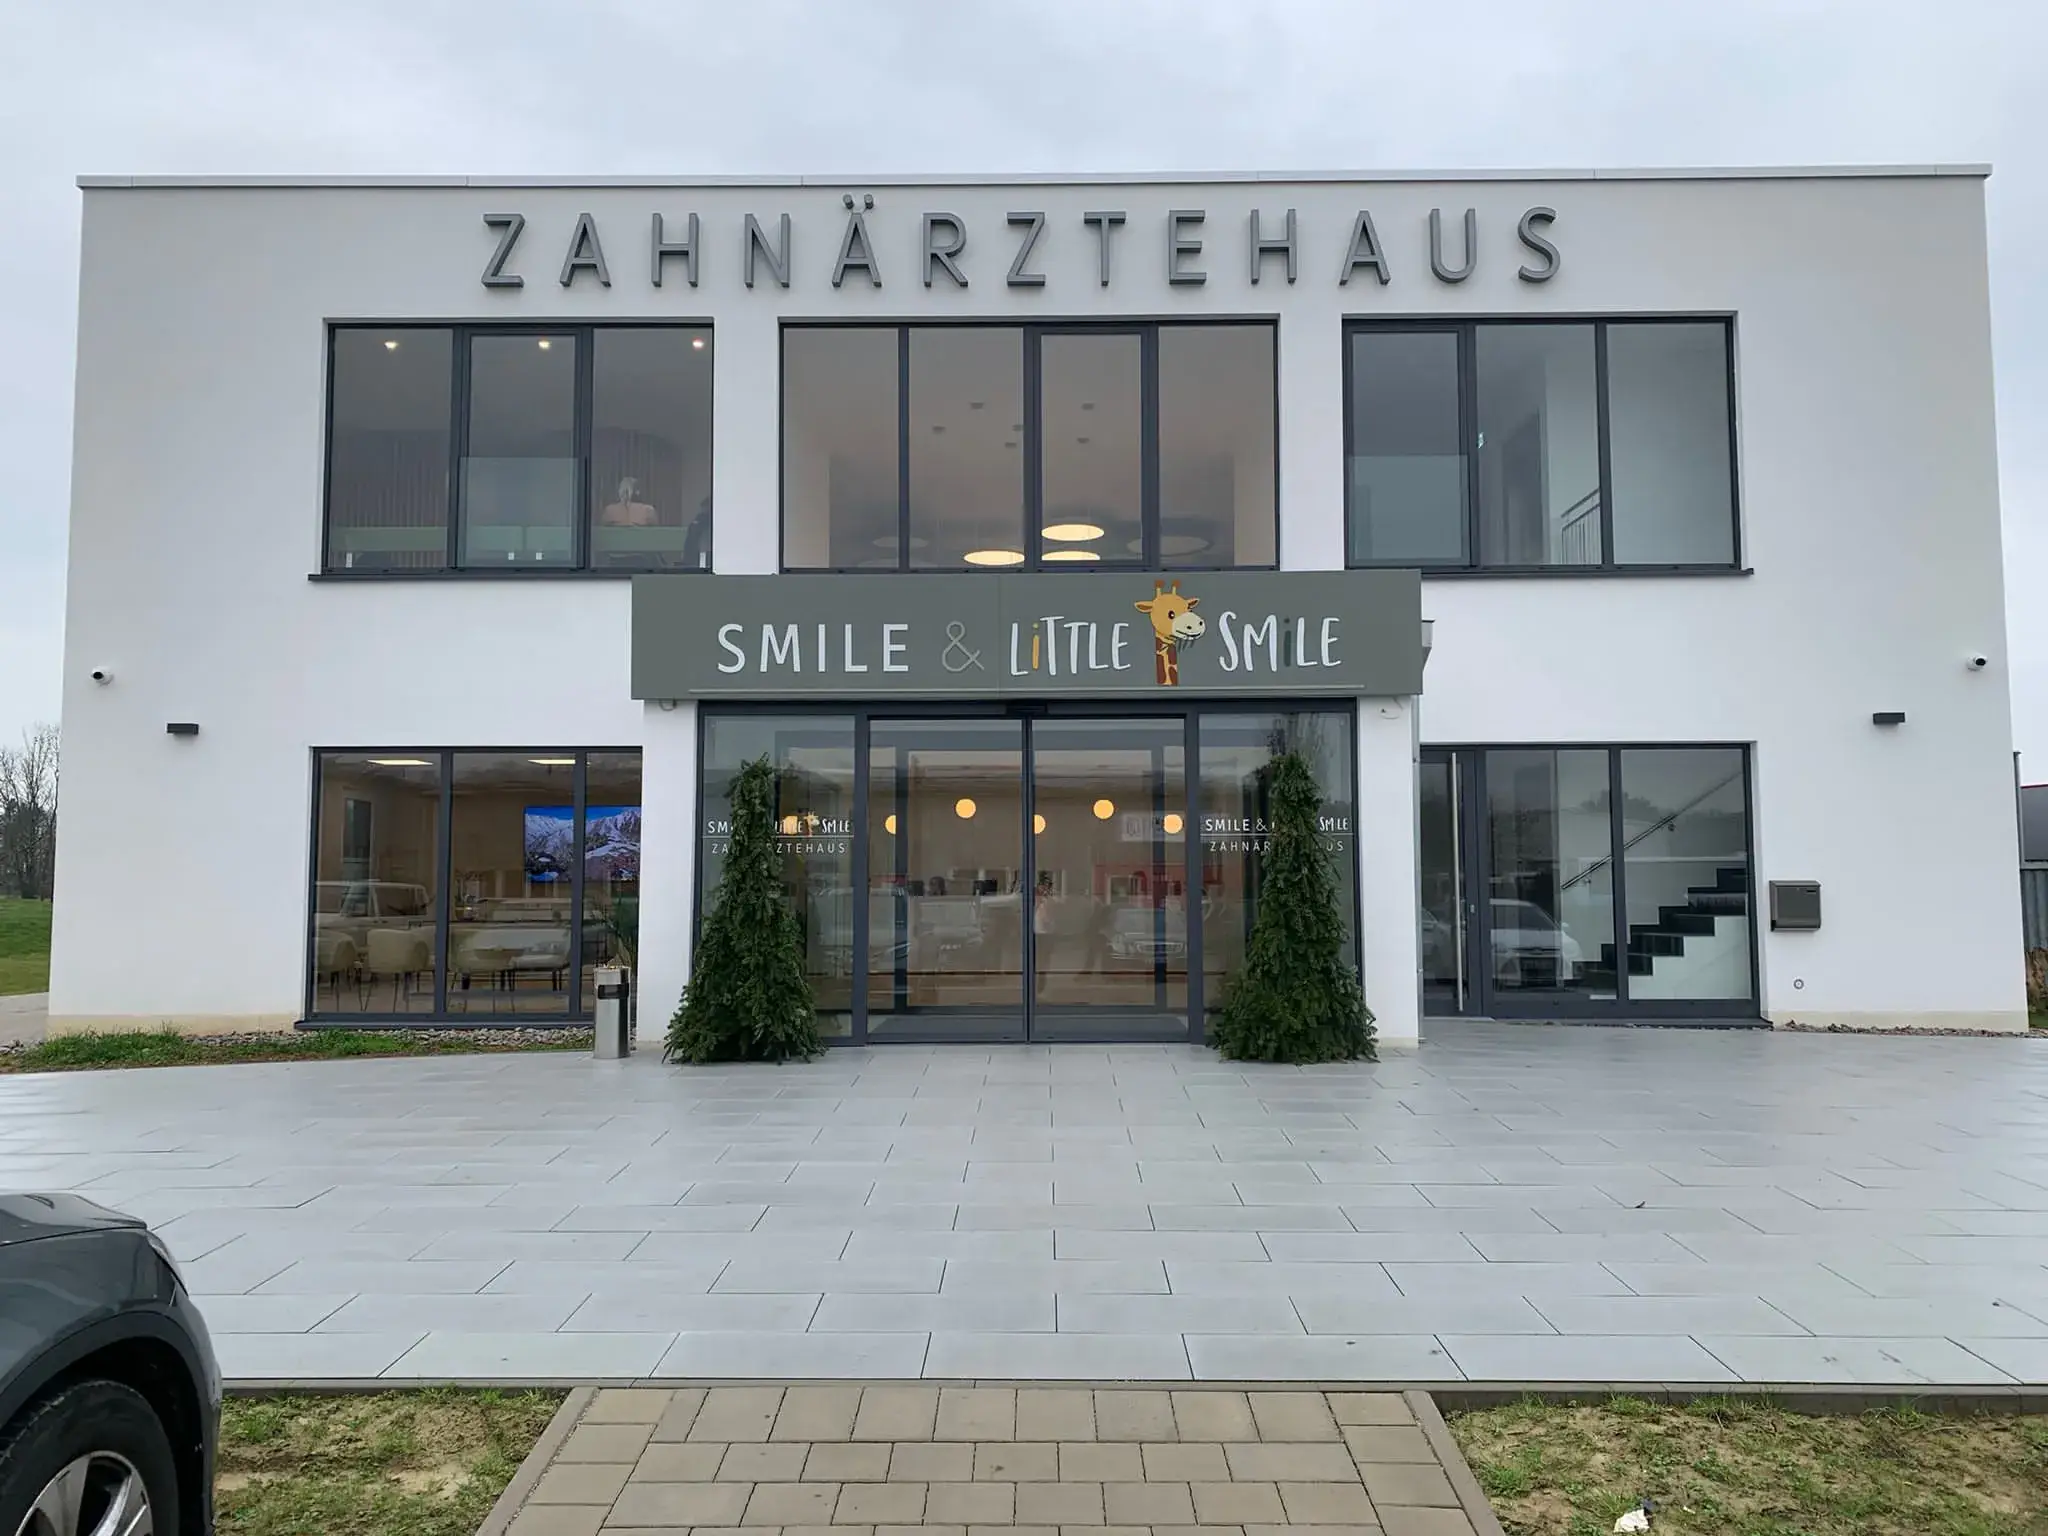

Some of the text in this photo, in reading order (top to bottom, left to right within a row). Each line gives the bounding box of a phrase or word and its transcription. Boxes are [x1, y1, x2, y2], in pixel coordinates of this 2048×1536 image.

[481, 193, 1561, 288] ZAHNÄRZTEHAUS
[717, 623, 909, 673] SMILE
[941, 620, 985, 672] &
[1205, 818, 1250, 832] SMILE
[1255, 817, 1268, 832] &
